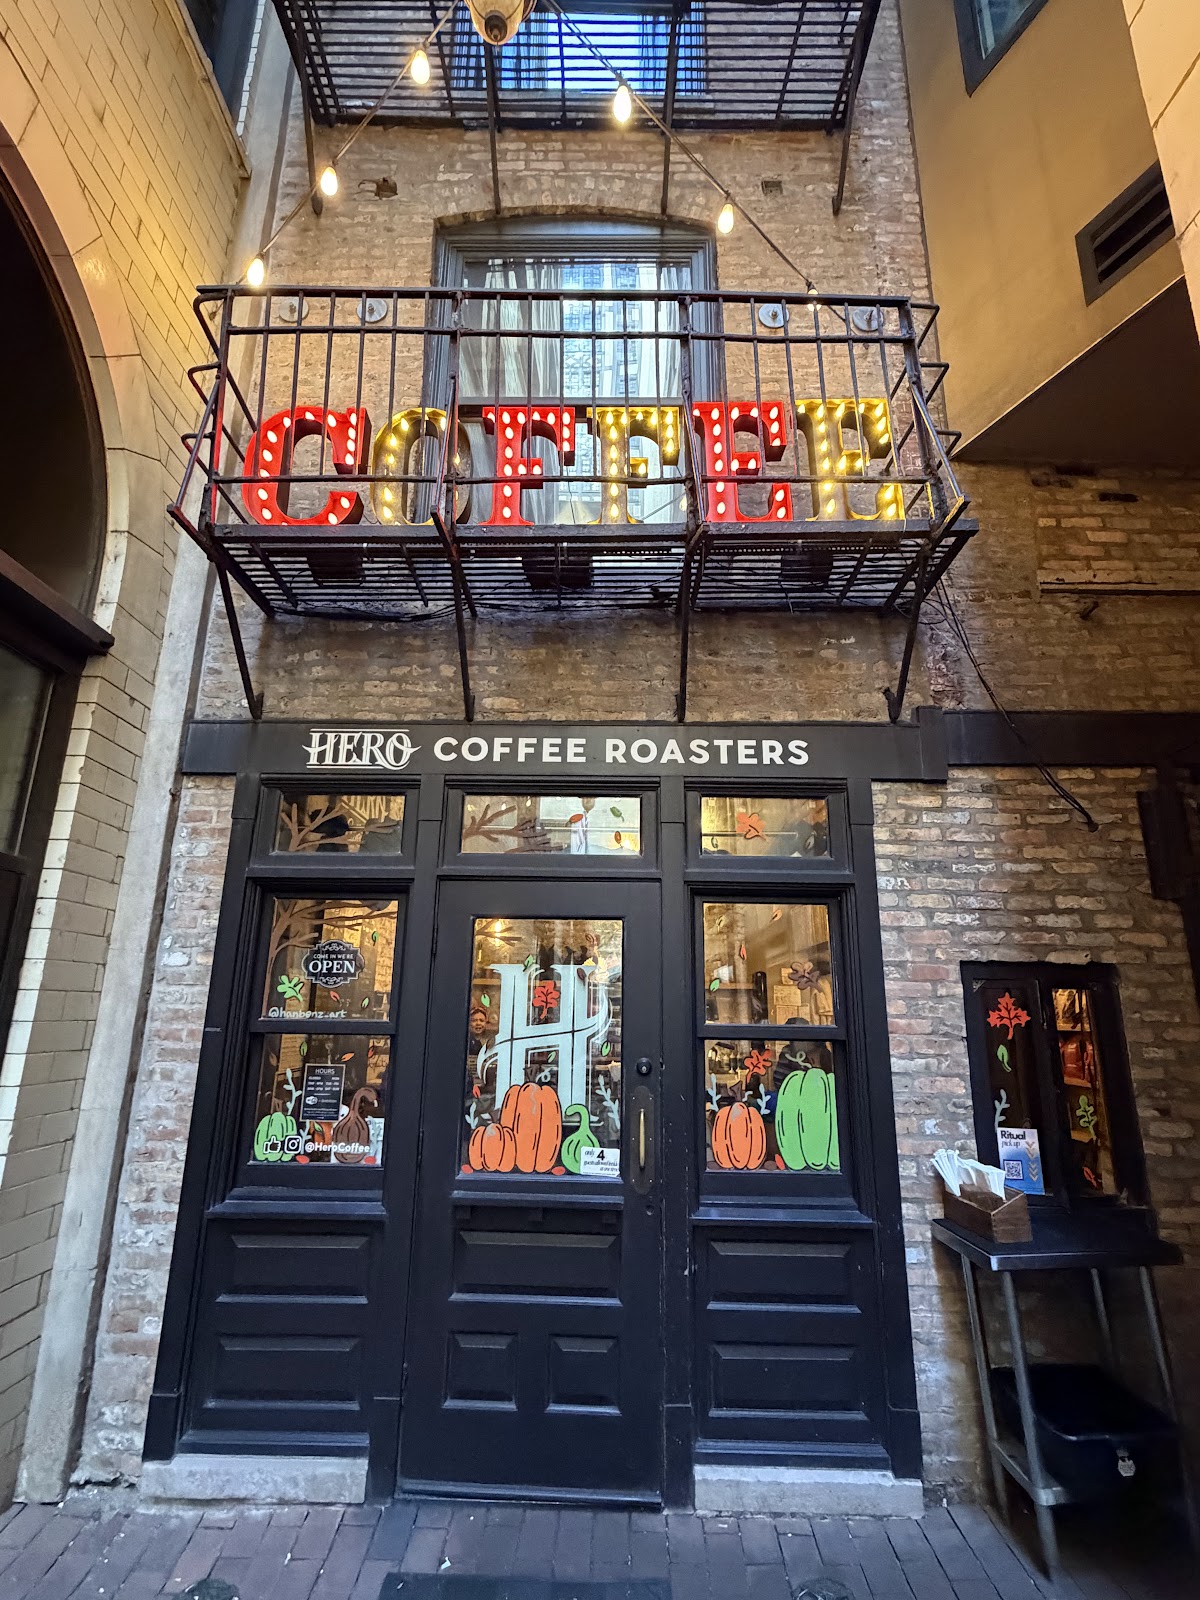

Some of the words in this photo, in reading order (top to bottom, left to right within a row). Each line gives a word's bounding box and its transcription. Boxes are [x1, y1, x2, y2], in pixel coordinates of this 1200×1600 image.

[243, 397, 907, 527] COFFEE
[302, 729, 421, 770] HERO
[434, 736, 587, 764] COFFEE
[606, 738, 810, 766] ROASTERS
[308, 960, 356, 974] OPEN
[1000, 1130, 1026, 1140] Ritual
[304, 1142, 371, 1153] @HeroCoffee
[596, 1149, 605, 1161] 4
